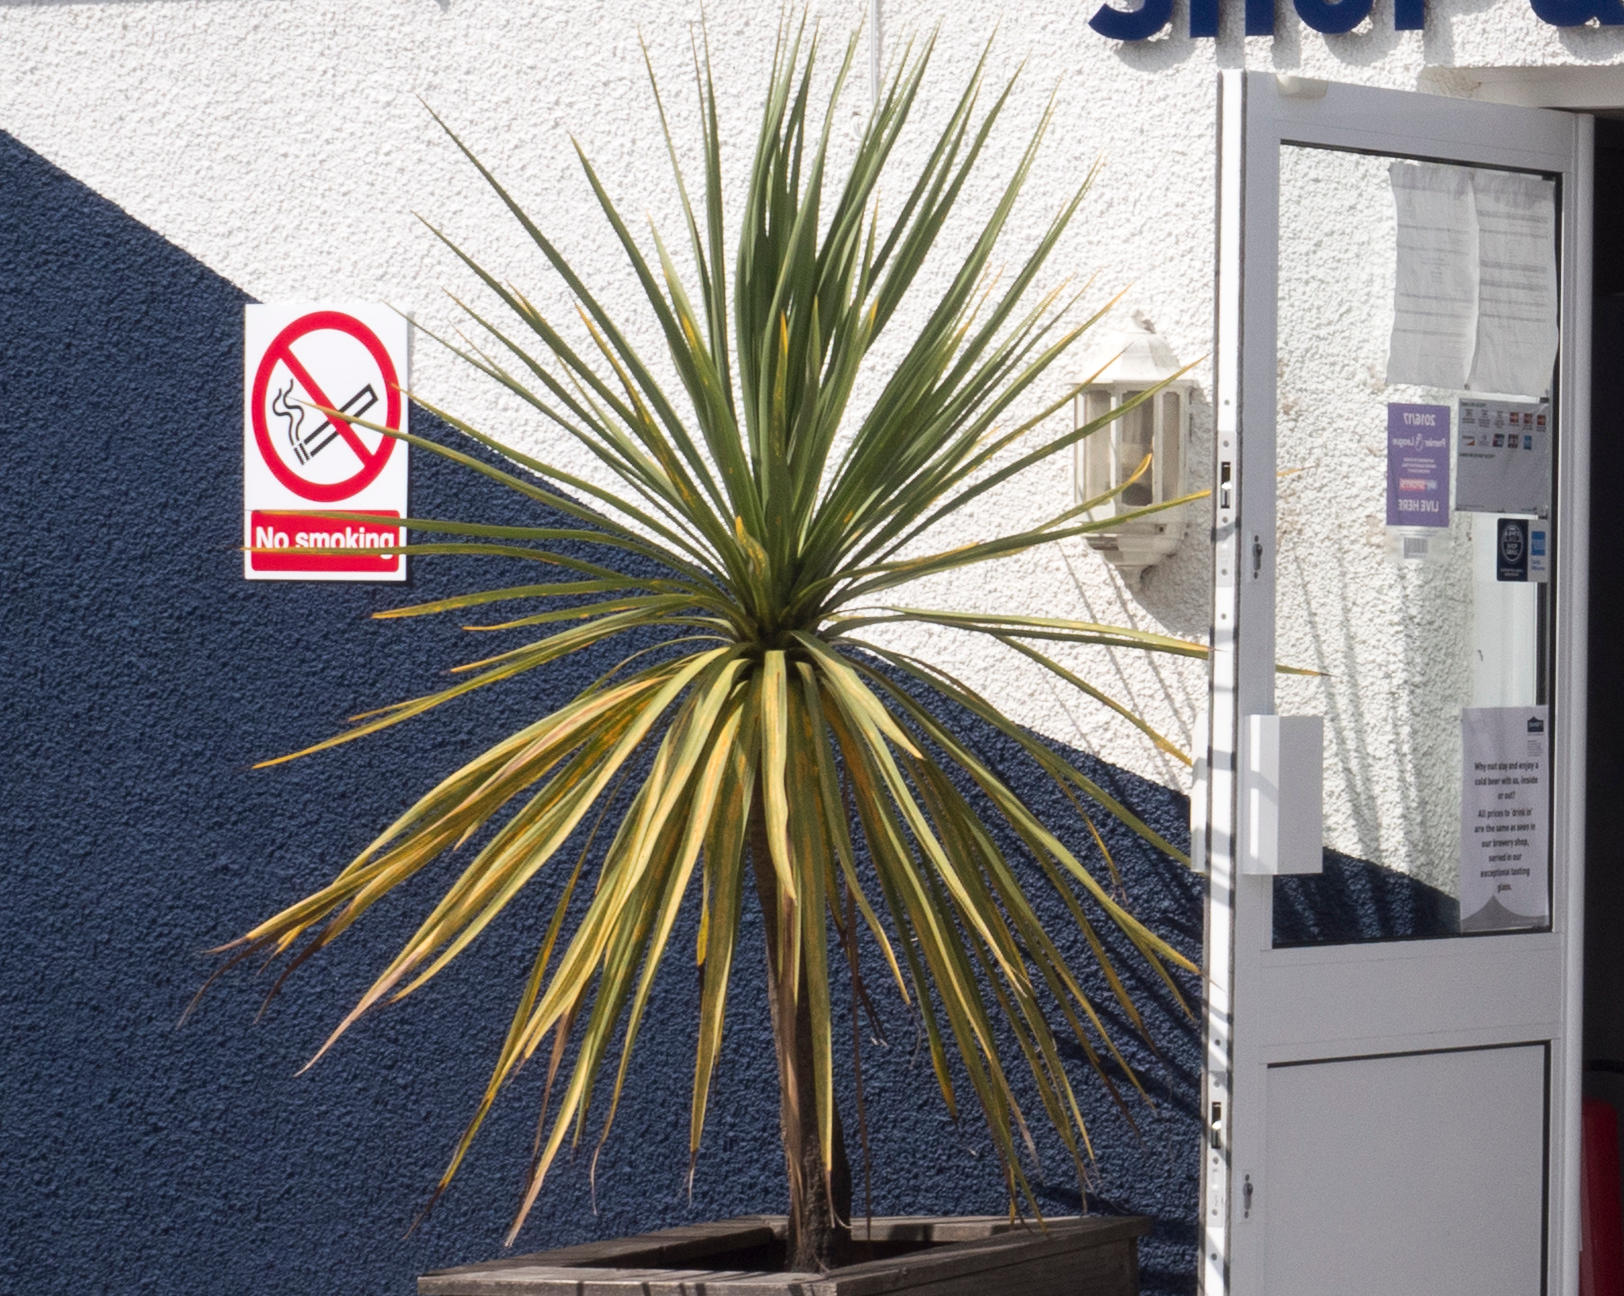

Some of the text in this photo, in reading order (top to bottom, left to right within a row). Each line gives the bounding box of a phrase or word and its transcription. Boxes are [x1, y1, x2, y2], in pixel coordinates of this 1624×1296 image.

[256, 525, 395, 560] No smoking
[1492, 839, 1514, 849] brewery
